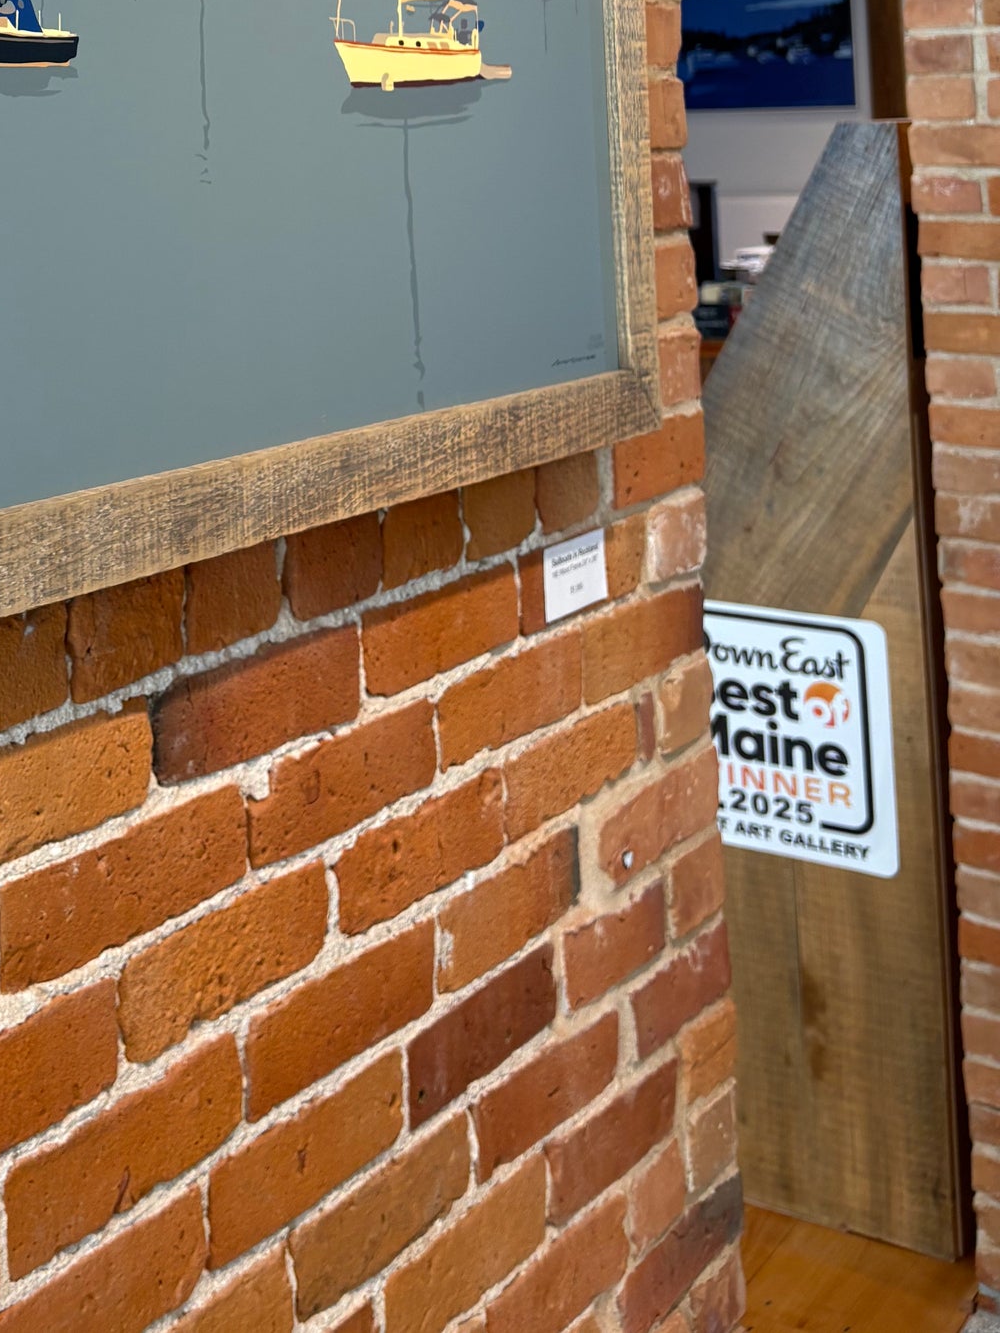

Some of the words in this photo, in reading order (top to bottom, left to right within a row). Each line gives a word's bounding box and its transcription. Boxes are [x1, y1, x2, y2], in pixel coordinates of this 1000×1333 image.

[703, 631, 778, 670] own
[779, 636, 851, 680] East
[712, 677, 799, 721] est
[711, 713, 848, 776] Maine
[718, 762, 852, 808] INNER
[735, 820, 773, 841] ART
[779, 830, 870, 861] GALLERY
